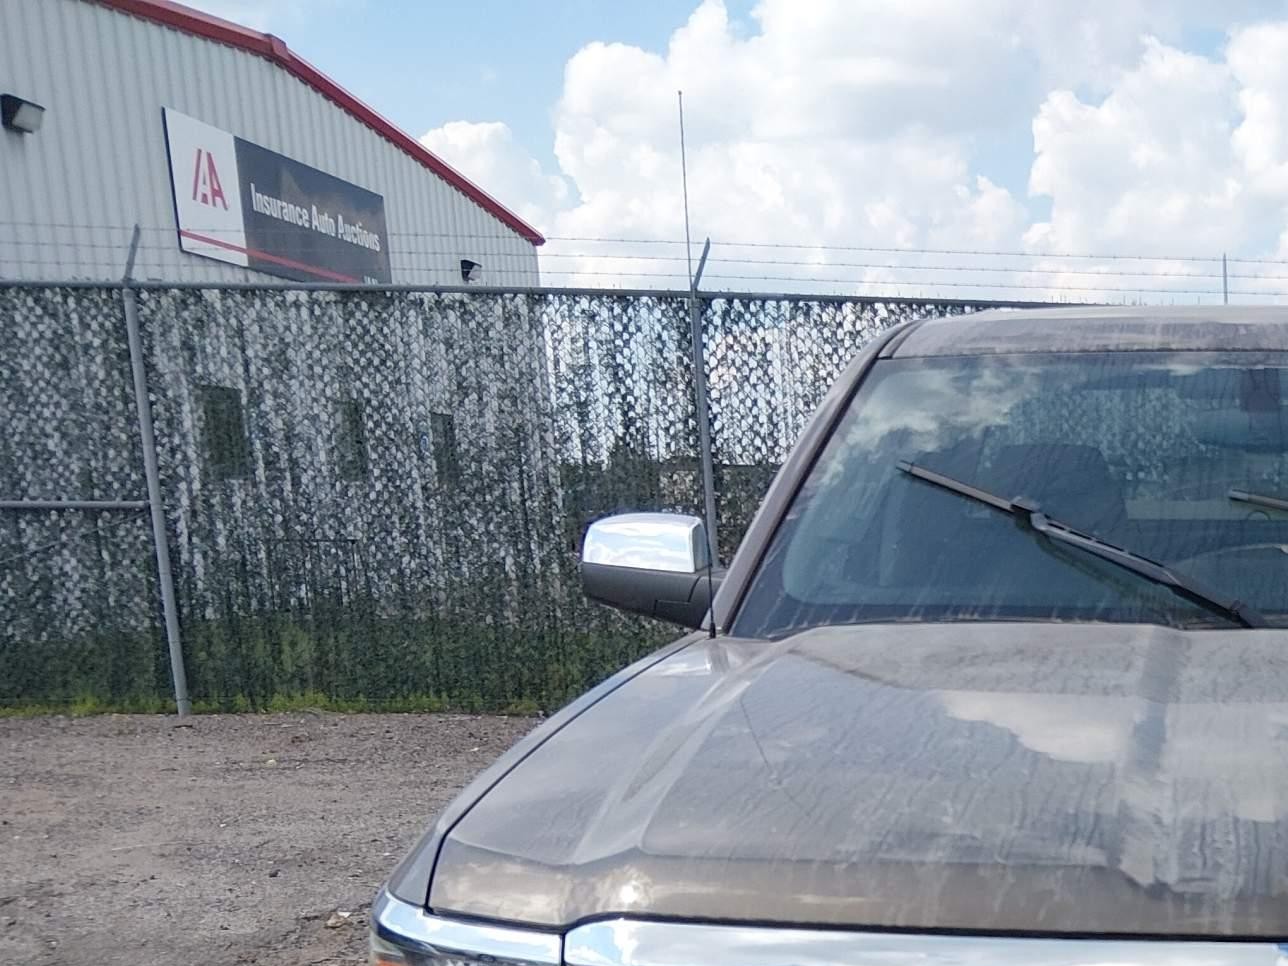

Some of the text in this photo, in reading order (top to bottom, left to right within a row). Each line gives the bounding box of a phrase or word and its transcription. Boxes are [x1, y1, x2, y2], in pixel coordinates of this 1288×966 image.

[250, 182, 380, 252] Insurance Auto Auctions
